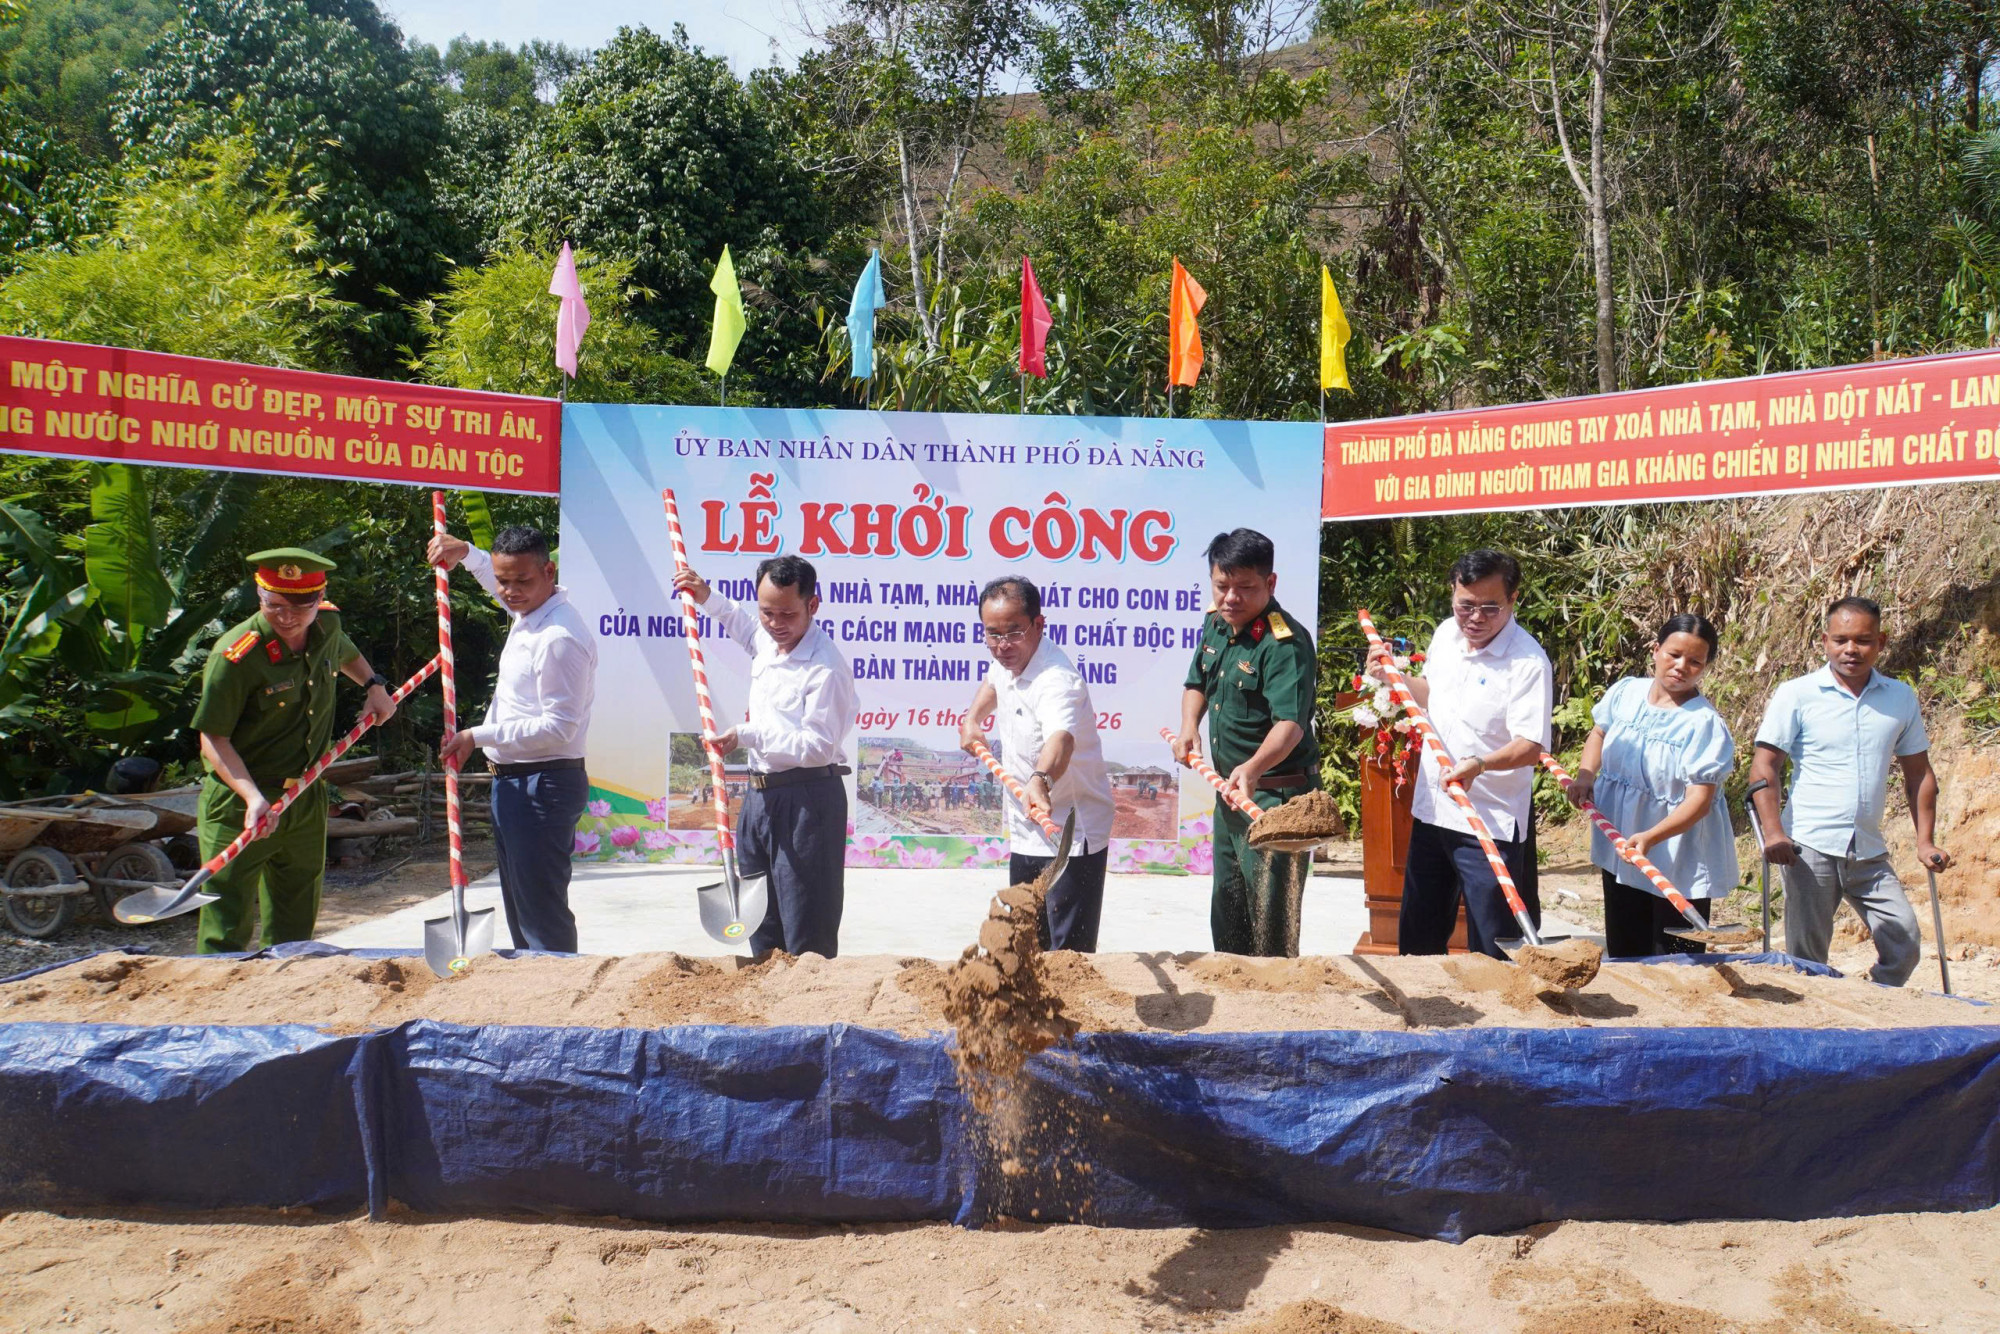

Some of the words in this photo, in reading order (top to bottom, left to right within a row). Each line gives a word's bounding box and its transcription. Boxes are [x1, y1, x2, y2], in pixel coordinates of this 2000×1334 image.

[11, 359, 88, 398] MỘT
[98, 370, 201, 406] NGHĨA
[212, 377, 258, 411] CỬ
[263, 388, 325, 421] ĐẸP,
[336, 395, 397, 429] MỘT
[405, 404, 446, 435] SỰ
[451, 410, 490, 435] TRI
[499, 410, 543, 443] ÂN,
[1340, 436, 1390, 465] THÀNH
[1394, 426, 1428, 461] PHỐ
[1430, 430, 1453, 457] ĐÀ
[1457, 420, 1505, 455] NẴNG
[1510, 420, 1572, 450] CHUNG
[1578, 416, 1609, 444] TAY
[1614, 407, 1653, 441] XOÁ
[1659, 401, 1703, 437] NHÀ
[1709, 400, 1762, 437] TẠM,
[1768, 388, 1816, 427] NHÀ
[1824, 384, 1870, 426] DỘT
[1876, 378, 1926, 416] NÁT
[46, 410, 141, 444] NƯỚC
[152, 419, 220, 450] NHỚ
[229, 426, 335, 461] NGUỒN
[345, 433, 402, 466] CỦA
[411, 442, 467, 472] DÂN
[475, 448, 524, 480] TỘC
[674, 430, 710, 457] ỦY
[717, 438, 771, 458] BAN
[778, 435, 854, 460] NHÂN
[862, 437, 917, 461] DÂN
[924, 440, 1016, 464] THÀNH
[1025, 438, 1081, 465] PHỐ
[1087, 442, 1123, 466] ĐÀ
[1131, 437, 1206, 469] NẴNG
[1375, 473, 1400, 502] VỚI
[1404, 475, 1430, 500] GIA
[1435, 468, 1475, 498] ĐÌNH
[1480, 462, 1534, 496] NGƯỜI
[1539, 462, 1591, 492] THAM
[1597, 457, 1630, 487] GIA
[1635, 450, 1706, 483] KHÁNG
[1712, 439, 1778, 479] CHIẾN
[1785, 444, 1808, 479] BỊ
[1815, 428, 1895, 471] NHIỄM
[1903, 420, 1969, 465] CHẤT
[700, 472, 780, 555] LỄ
[799, 483, 971, 559] KHỞI
[988, 490, 1178, 564] CÔNG
[830, 578, 873, 604] NHÀ
[879, 583, 930, 610] TẠM,
[937, 580, 979, 606] NHÀ
[1078, 587, 1119, 609] CHO
[1126, 588, 1169, 611] CON
[1175, 583, 1202, 612] ĐẺ
[600, 607, 641, 637] CỦA
[841, 616, 897, 642] CÁCH
[904, 621, 966, 648] MẠNG
[1074, 618, 1128, 647] CHẤT
[1133, 622, 1175, 652] ĐỘC
[853, 654, 896, 680] BÀN
[902, 655, 970, 681] THÀNH
[907, 708, 931, 726] 16
